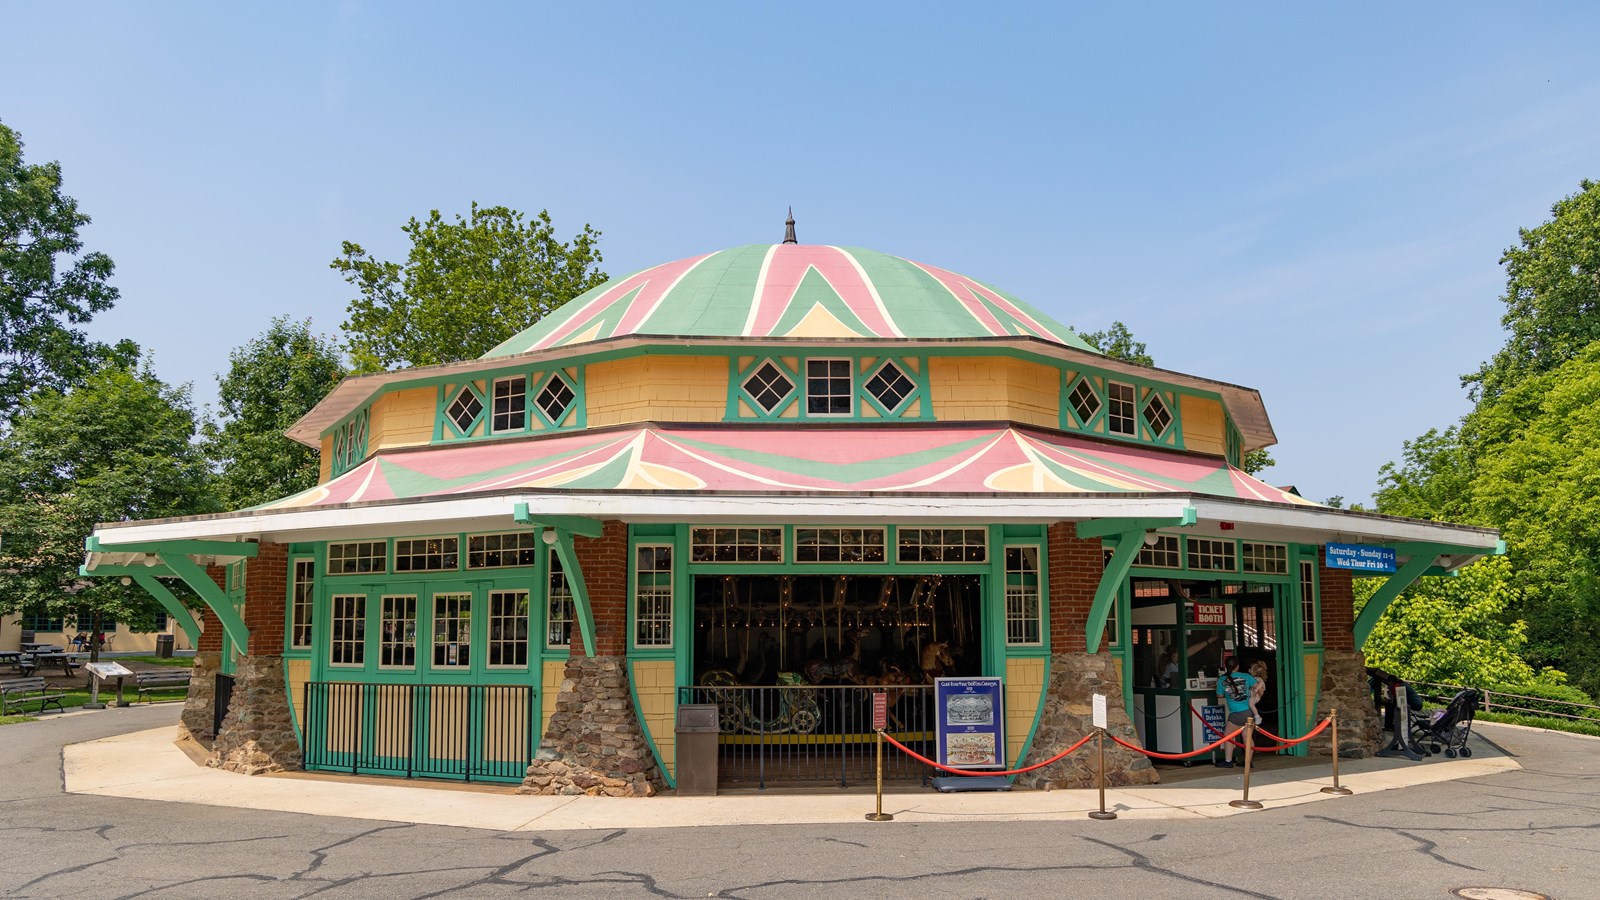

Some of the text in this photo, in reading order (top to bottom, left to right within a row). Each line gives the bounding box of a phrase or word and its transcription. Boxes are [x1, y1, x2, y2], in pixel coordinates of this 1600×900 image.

[1330, 546, 1356, 557] Saturday
[1360, 549, 1381, 560] Sunday
[1337, 558, 1350, 566] Wed
[1350, 558, 1366, 568] Thur
[1366, 560, 1376, 568] Fri
[1198, 604, 1224, 614] TICKET
[1198, 614, 1224, 622] BOOTH
